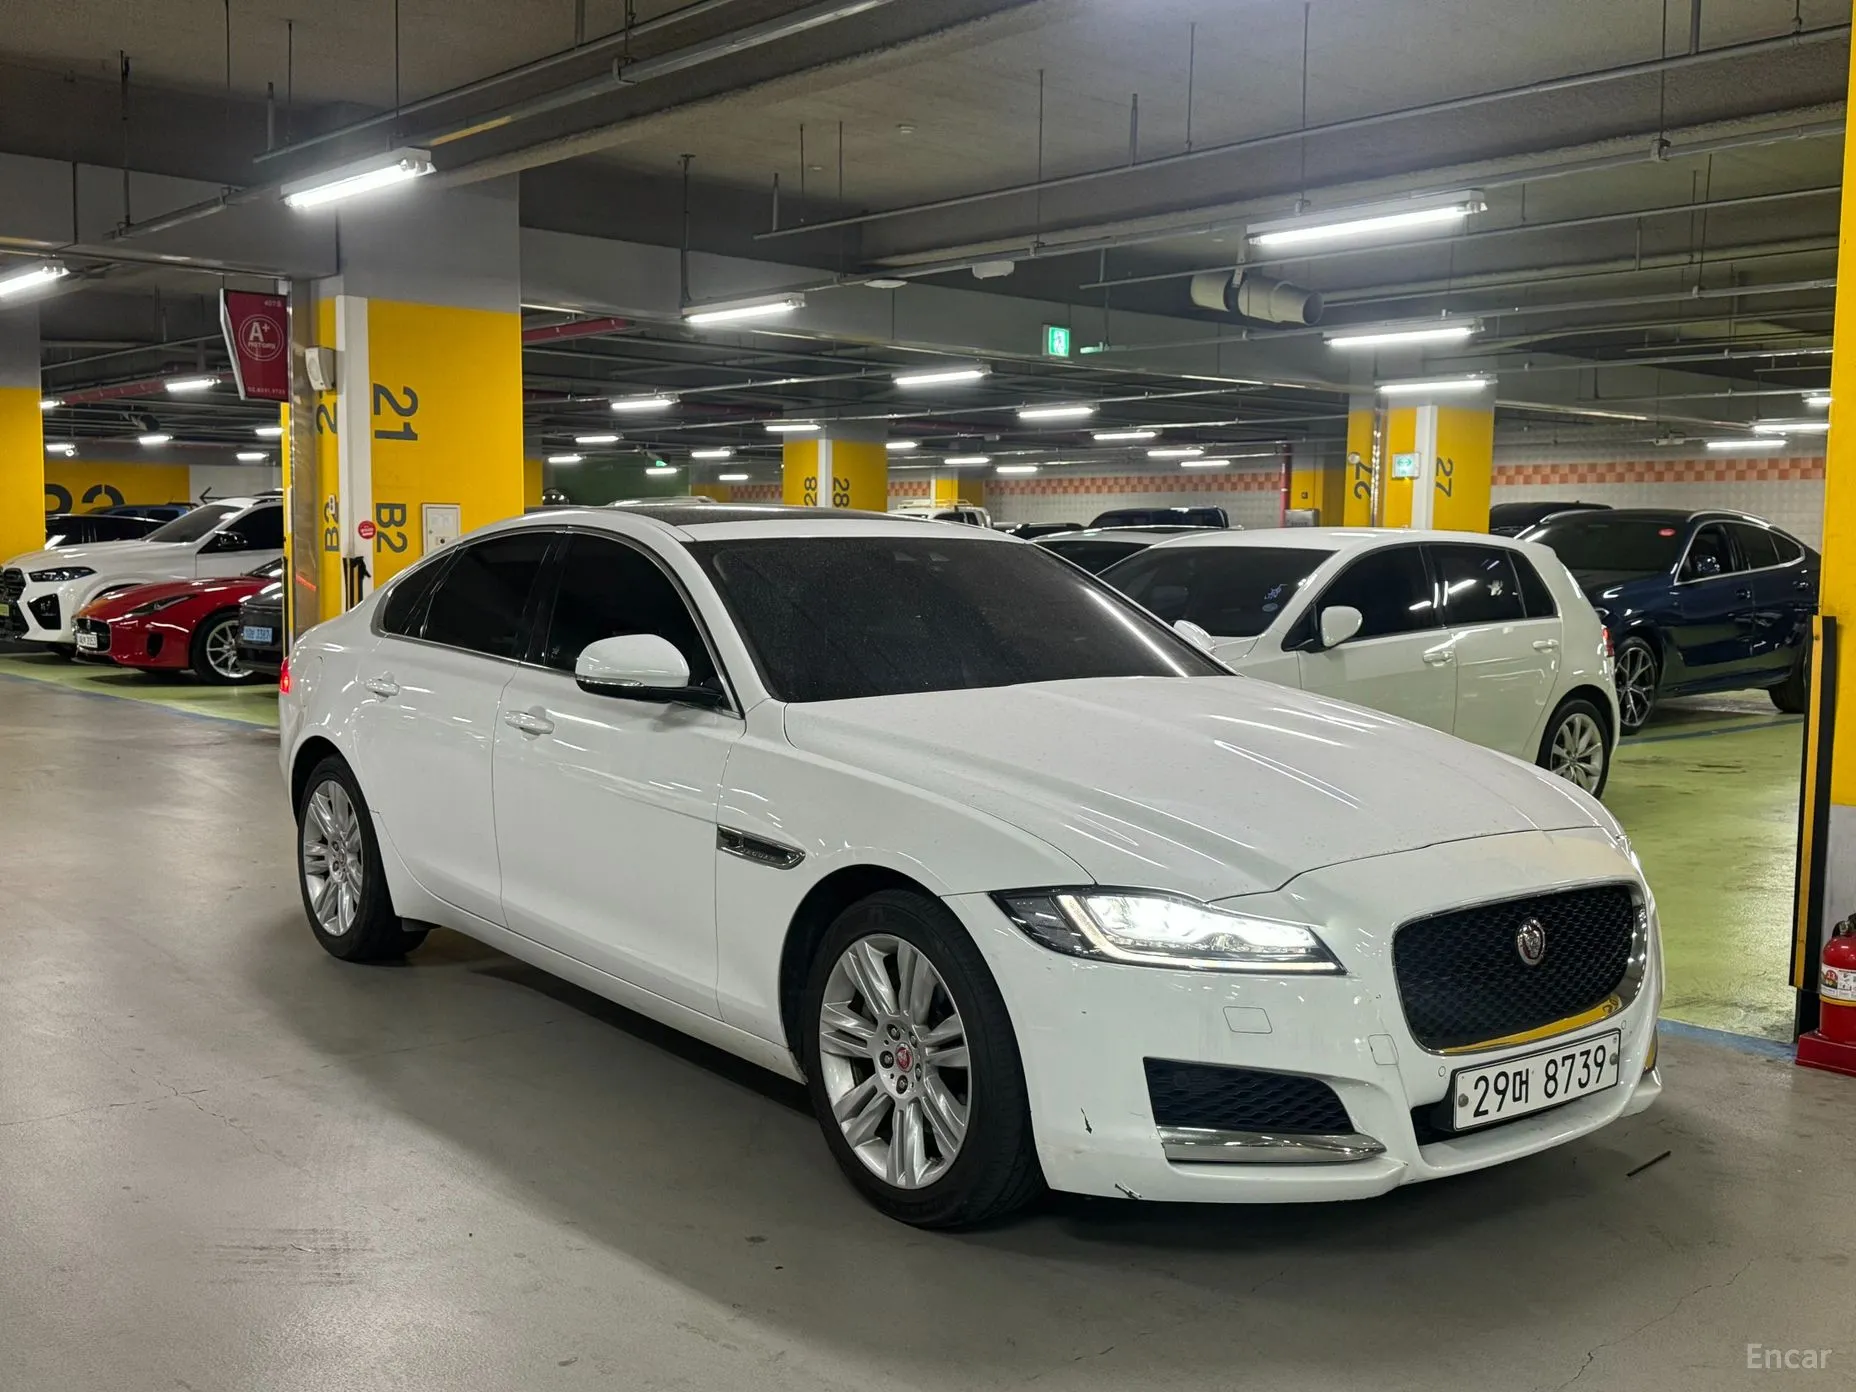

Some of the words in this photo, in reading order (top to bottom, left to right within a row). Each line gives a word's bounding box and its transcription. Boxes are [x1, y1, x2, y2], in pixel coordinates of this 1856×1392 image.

[373, 383, 419, 441] 21
[804, 476, 817, 507] 28
[833, 477, 850, 508] 28
[1436, 457, 1454, 498] 27
[375, 502, 408, 553] B2
[1473, 1068, 1530, 1118] 29머
[1544, 1045, 1606, 1099] 8739
